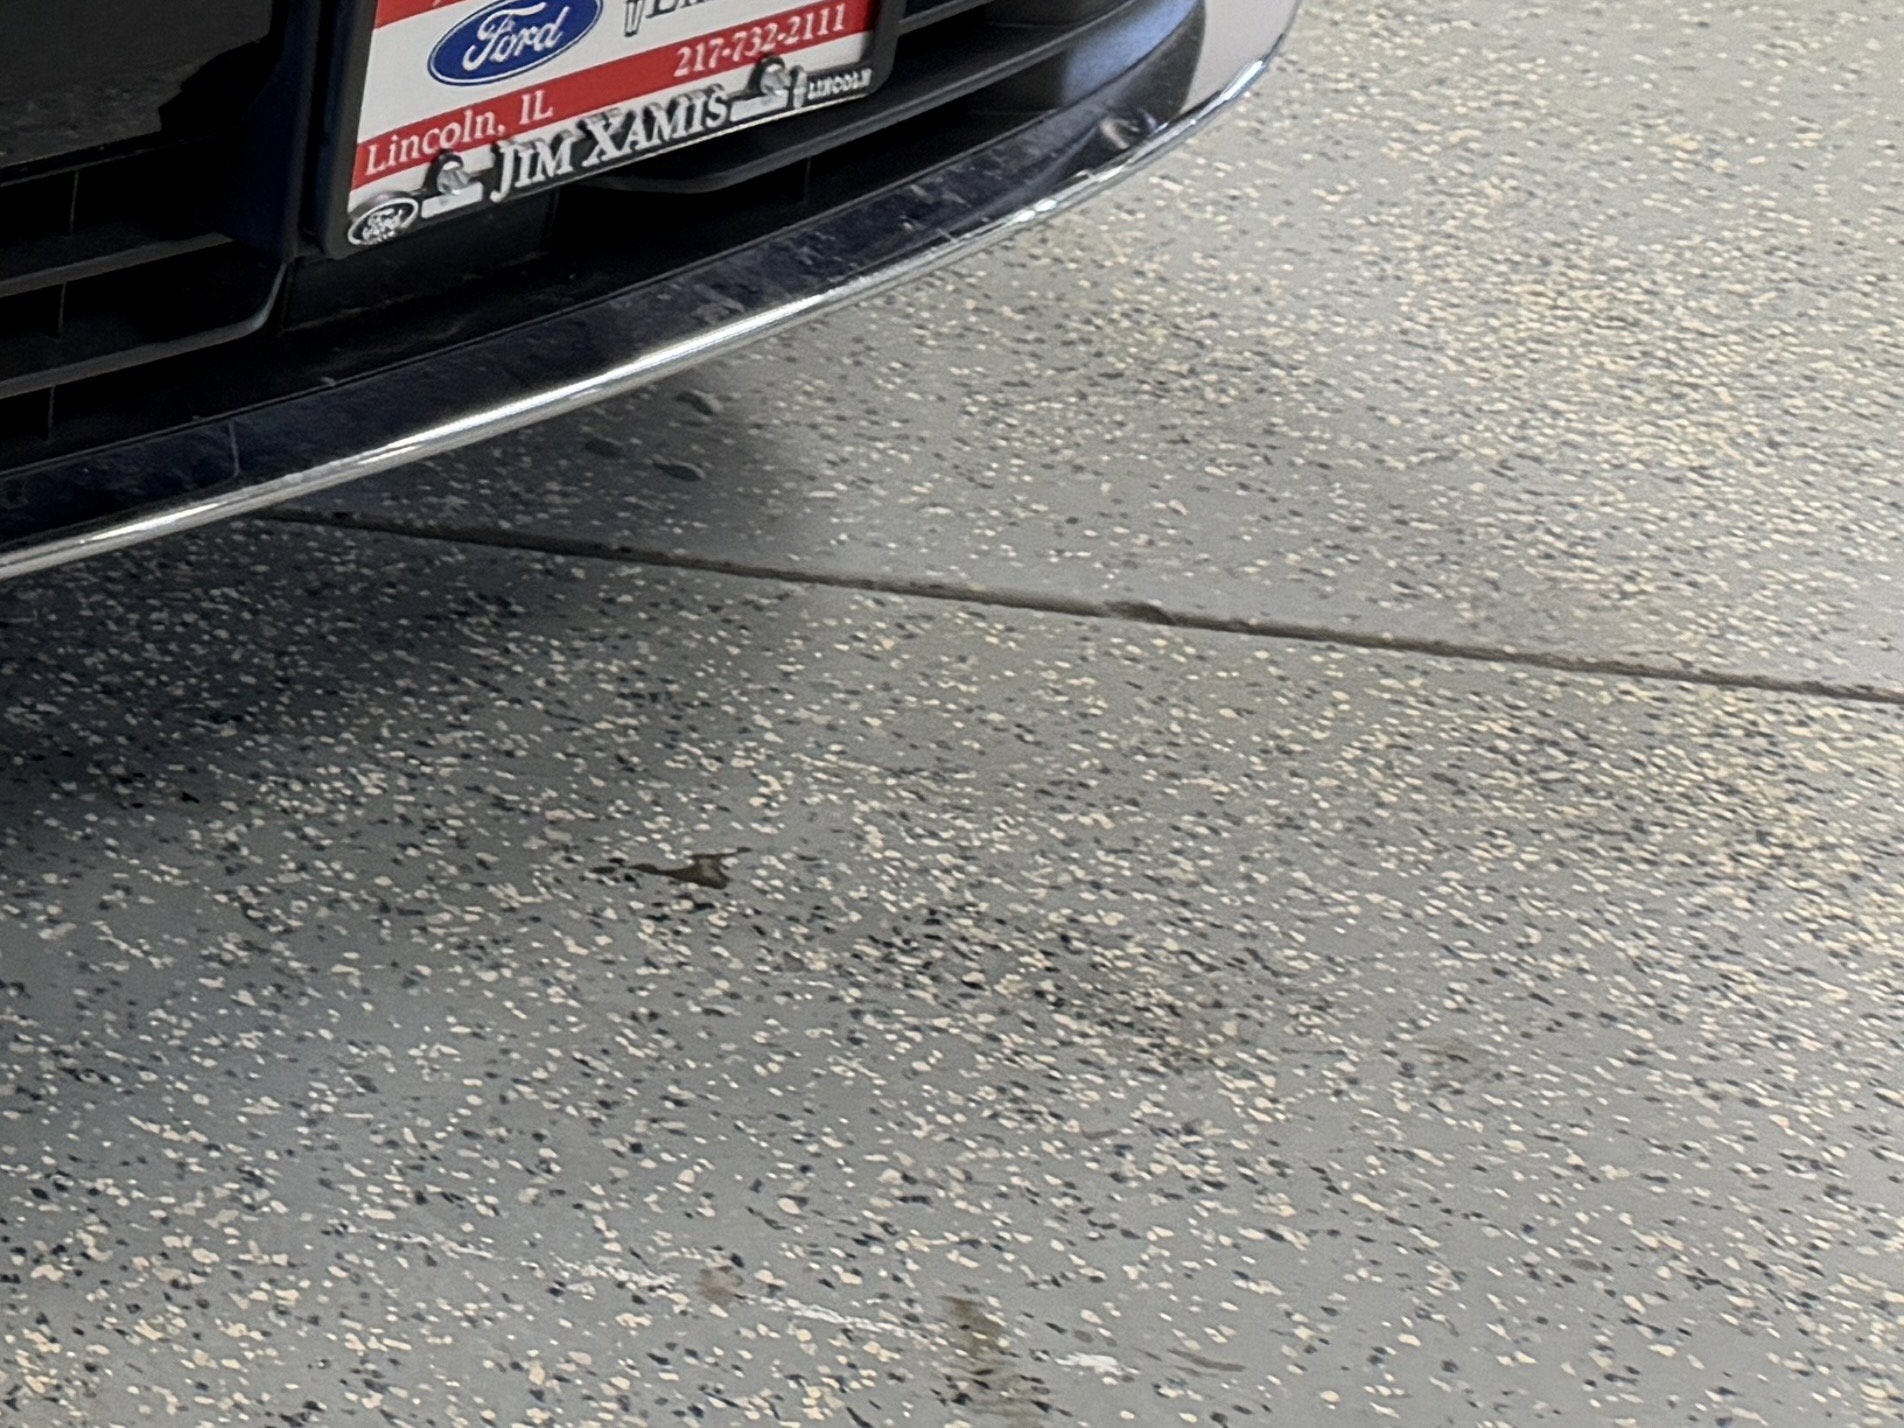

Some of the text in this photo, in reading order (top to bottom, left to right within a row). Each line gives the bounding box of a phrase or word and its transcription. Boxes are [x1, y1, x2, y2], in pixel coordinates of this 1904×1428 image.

[461, 1, 571, 72] Ford
[673, 2, 846, 78] 217-732-2111
[807, 67, 874, 101] LINCOLN
[363, 90, 554, 177] Lincoln, IL
[489, 87, 729, 204] JIM XAMIS
